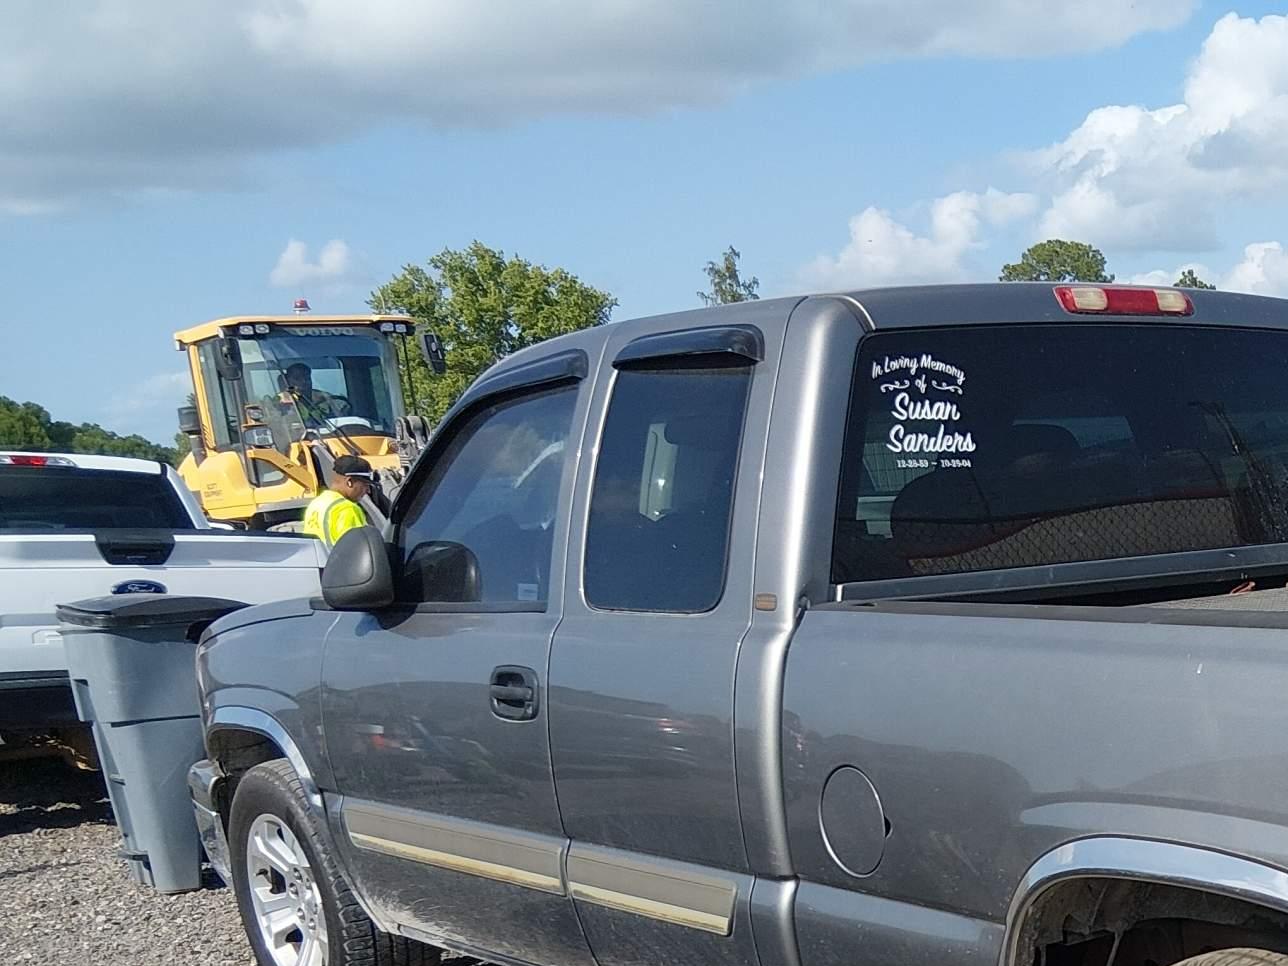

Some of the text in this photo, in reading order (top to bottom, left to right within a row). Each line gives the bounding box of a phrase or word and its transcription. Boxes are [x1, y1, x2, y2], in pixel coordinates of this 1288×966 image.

[295, 327, 354, 337] VOLVO
[872, 354, 965, 385] In Loving Memory
[914, 374, 927, 393] of
[891, 392, 960, 420] Susan
[886, 423, 976, 452] Sanders
